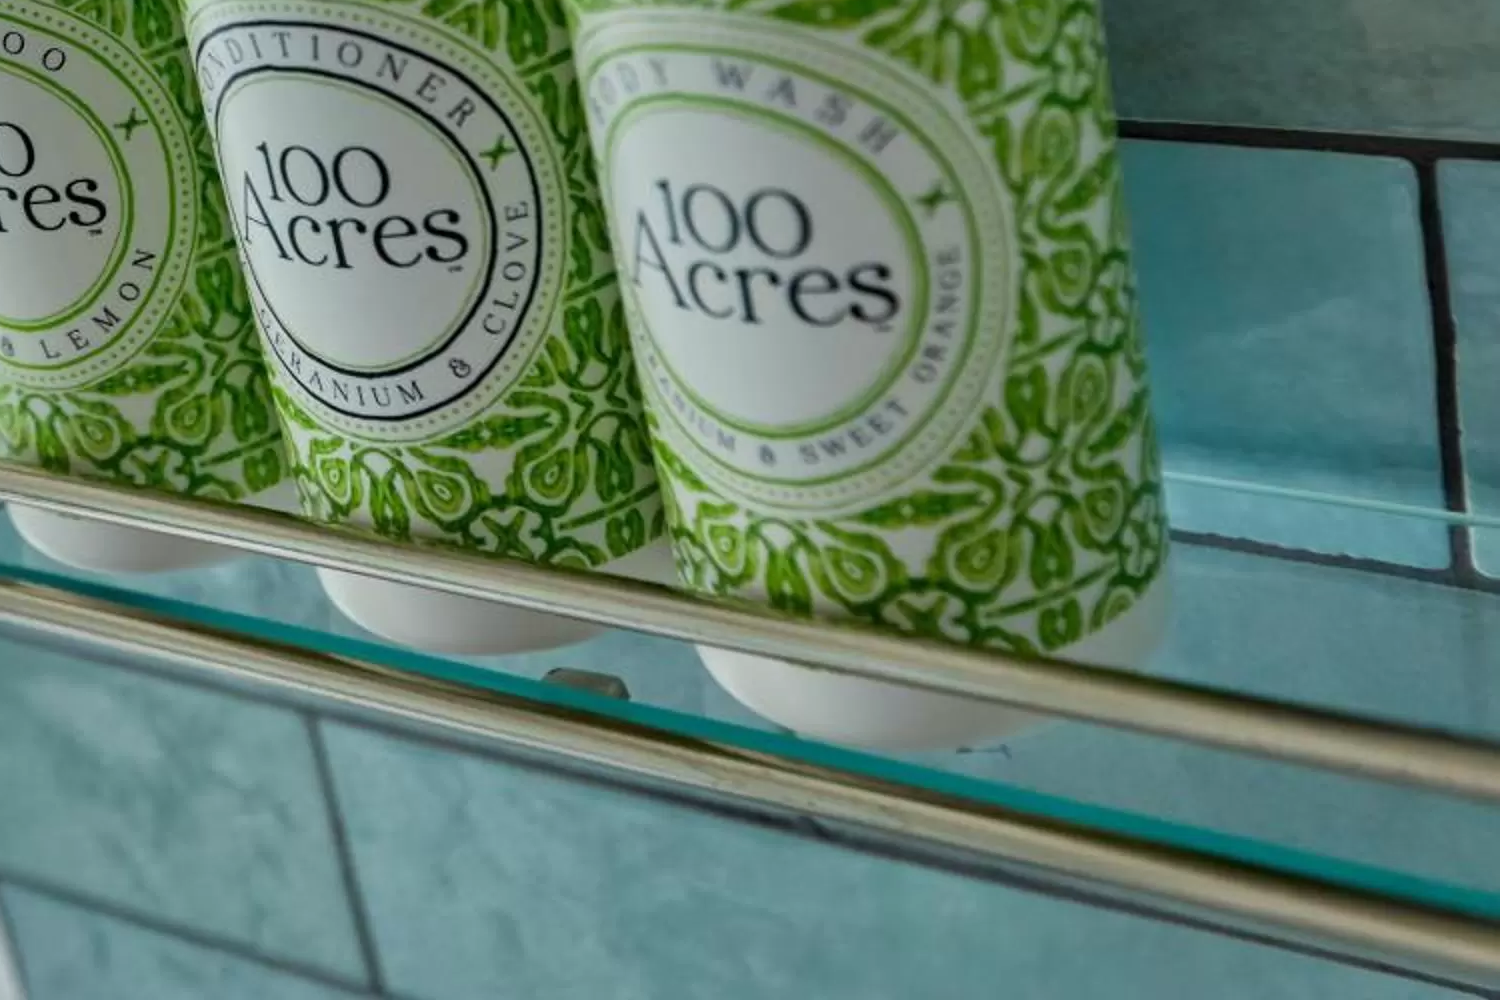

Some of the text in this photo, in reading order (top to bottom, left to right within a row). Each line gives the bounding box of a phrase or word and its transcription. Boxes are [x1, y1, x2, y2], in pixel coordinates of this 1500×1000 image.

[201, 32, 478, 128] ONDITIONER
[710, 58, 899, 155] WASH
[242, 170, 469, 270] Acres
[256, 141, 390, 208] 100
[655, 178, 814, 260] 100
[38, 248, 157, 360] LEMON
[448, 358, 472, 379] &
[482, 199, 531, 336] CLOVE
[631, 208, 901, 328] Acres
[798, 397, 909, 465] SWEET
[910, 244, 962, 385] ORANGE
